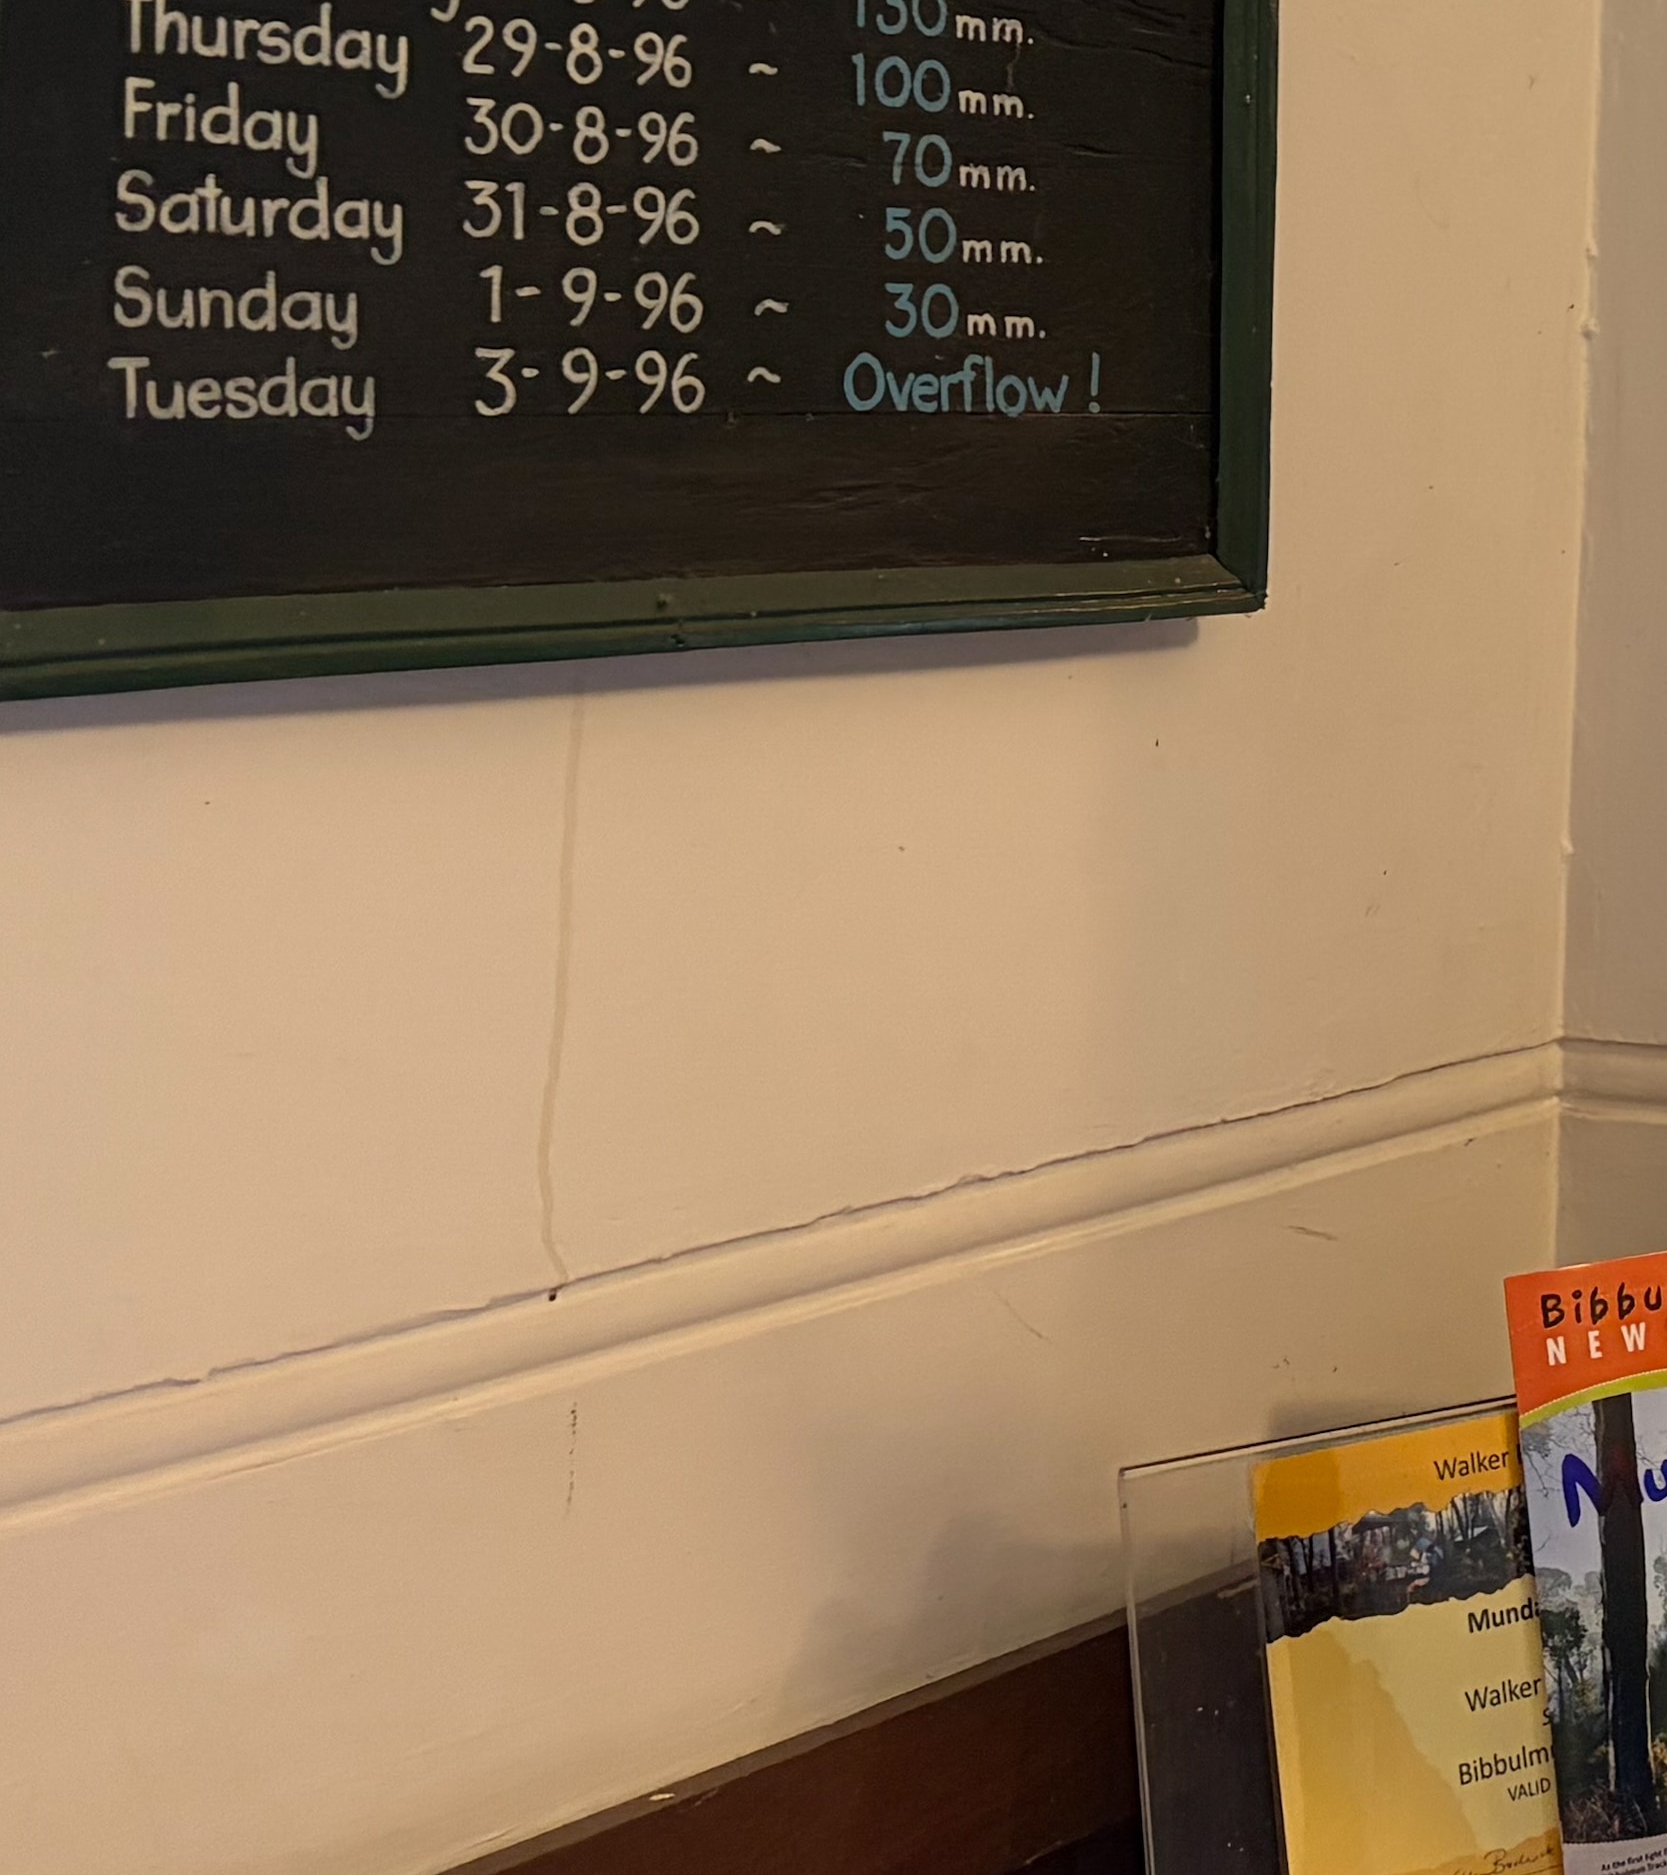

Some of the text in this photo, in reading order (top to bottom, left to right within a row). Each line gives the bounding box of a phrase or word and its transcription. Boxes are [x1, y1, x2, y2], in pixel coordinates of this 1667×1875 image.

[462, 16, 692, 88] 29-8-96
[851, 53, 951, 112] 100
[123, 76, 318, 179] Friday
[462, 96, 700, 167] 30-8-96
[882, 131, 952, 187] 70
[114, 169, 403, 265] Saturday
[462, 180, 700, 247] 31-8-96
[885, 207, 957, 263] 50
[113, 265, 358, 350] Sunday
[885, 283, 959, 338] 30
[107, 356, 375, 441] Tuesday
[1434, 1450, 1510, 1481] Walker
[1465, 1678, 1542, 1712] Walker
[1458, 1744, 1554, 1786] Bibbulm
[1507, 1777, 1551, 1802] VALID
[1612, 1860, 1625, 1869] the
